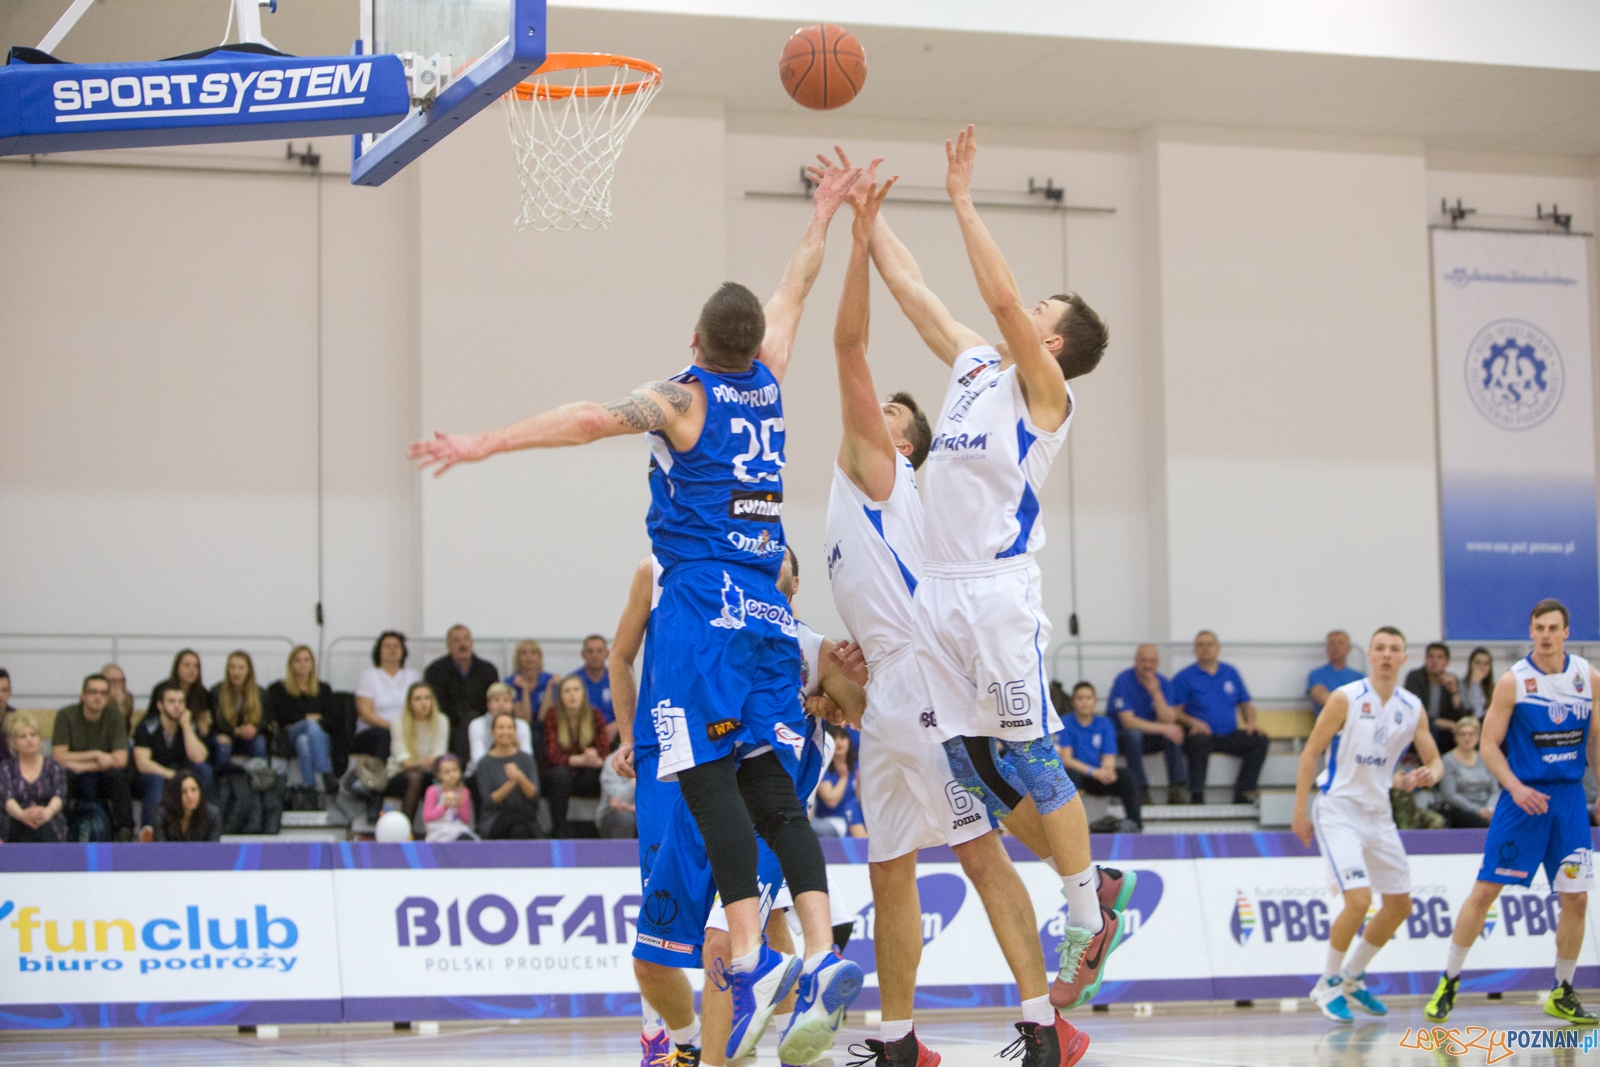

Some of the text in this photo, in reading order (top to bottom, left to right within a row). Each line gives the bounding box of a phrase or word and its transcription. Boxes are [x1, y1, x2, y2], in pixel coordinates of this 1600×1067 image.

[730, 417, 786, 485] 25
[988, 679, 1031, 717] 16
[944, 779, 974, 816] 6
[11, 904, 299, 953] funclub
[1258, 899, 1331, 943] PBG
[1405, 894, 1453, 939] BG
[19, 952, 298, 975] biuro podróży
[425, 955, 620, 972] POLSKI PRODUCENT
